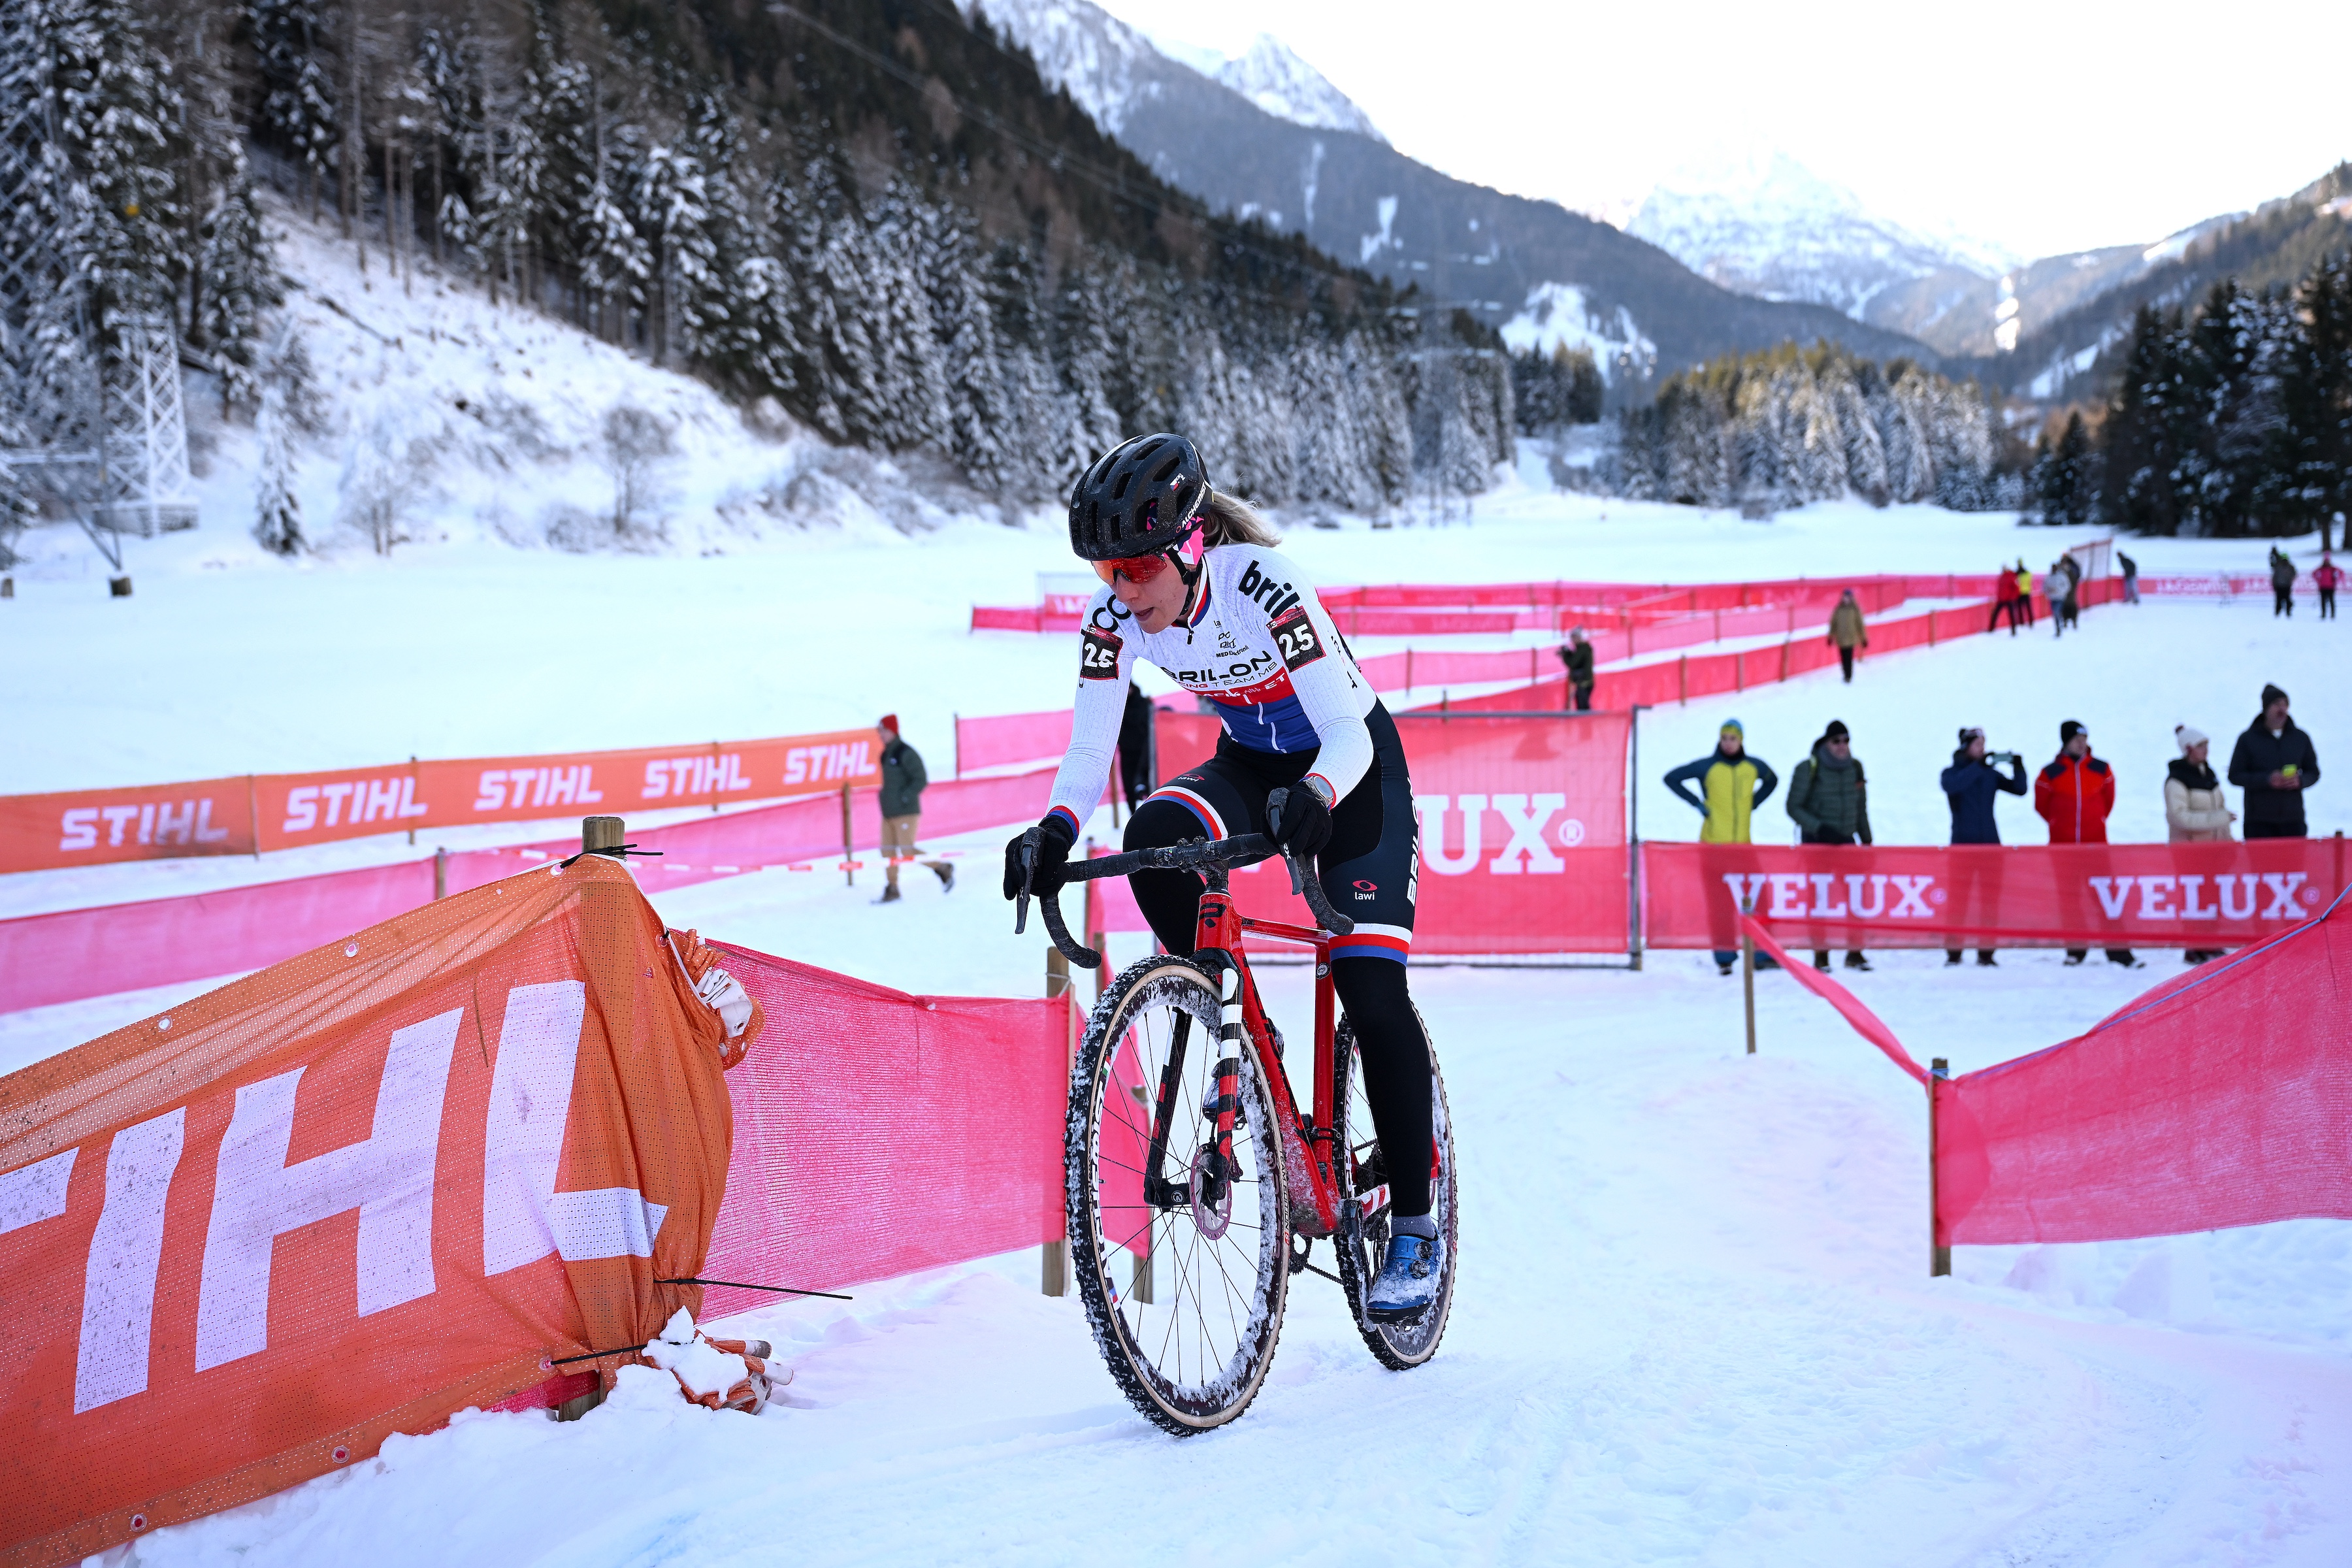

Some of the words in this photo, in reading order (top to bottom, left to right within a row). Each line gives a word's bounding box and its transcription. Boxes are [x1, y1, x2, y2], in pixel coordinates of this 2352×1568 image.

[1182, 483, 1207, 528] ALCHEMIST
[1084, 642, 1115, 668] 25
[1279, 623, 1315, 661] 25
[1211, 676, 1255, 687] TEAM
[1259, 661, 1277, 678] MB
[641, 753, 751, 798] STIHL
[783, 741, 876, 784] STIHL
[283, 776, 429, 833] STIHL
[474, 765, 603, 811] STIHL
[59, 798, 229, 852] STIHL
[1354, 892, 1375, 901] lawi
[0, 980, 668, 1415] IHL
